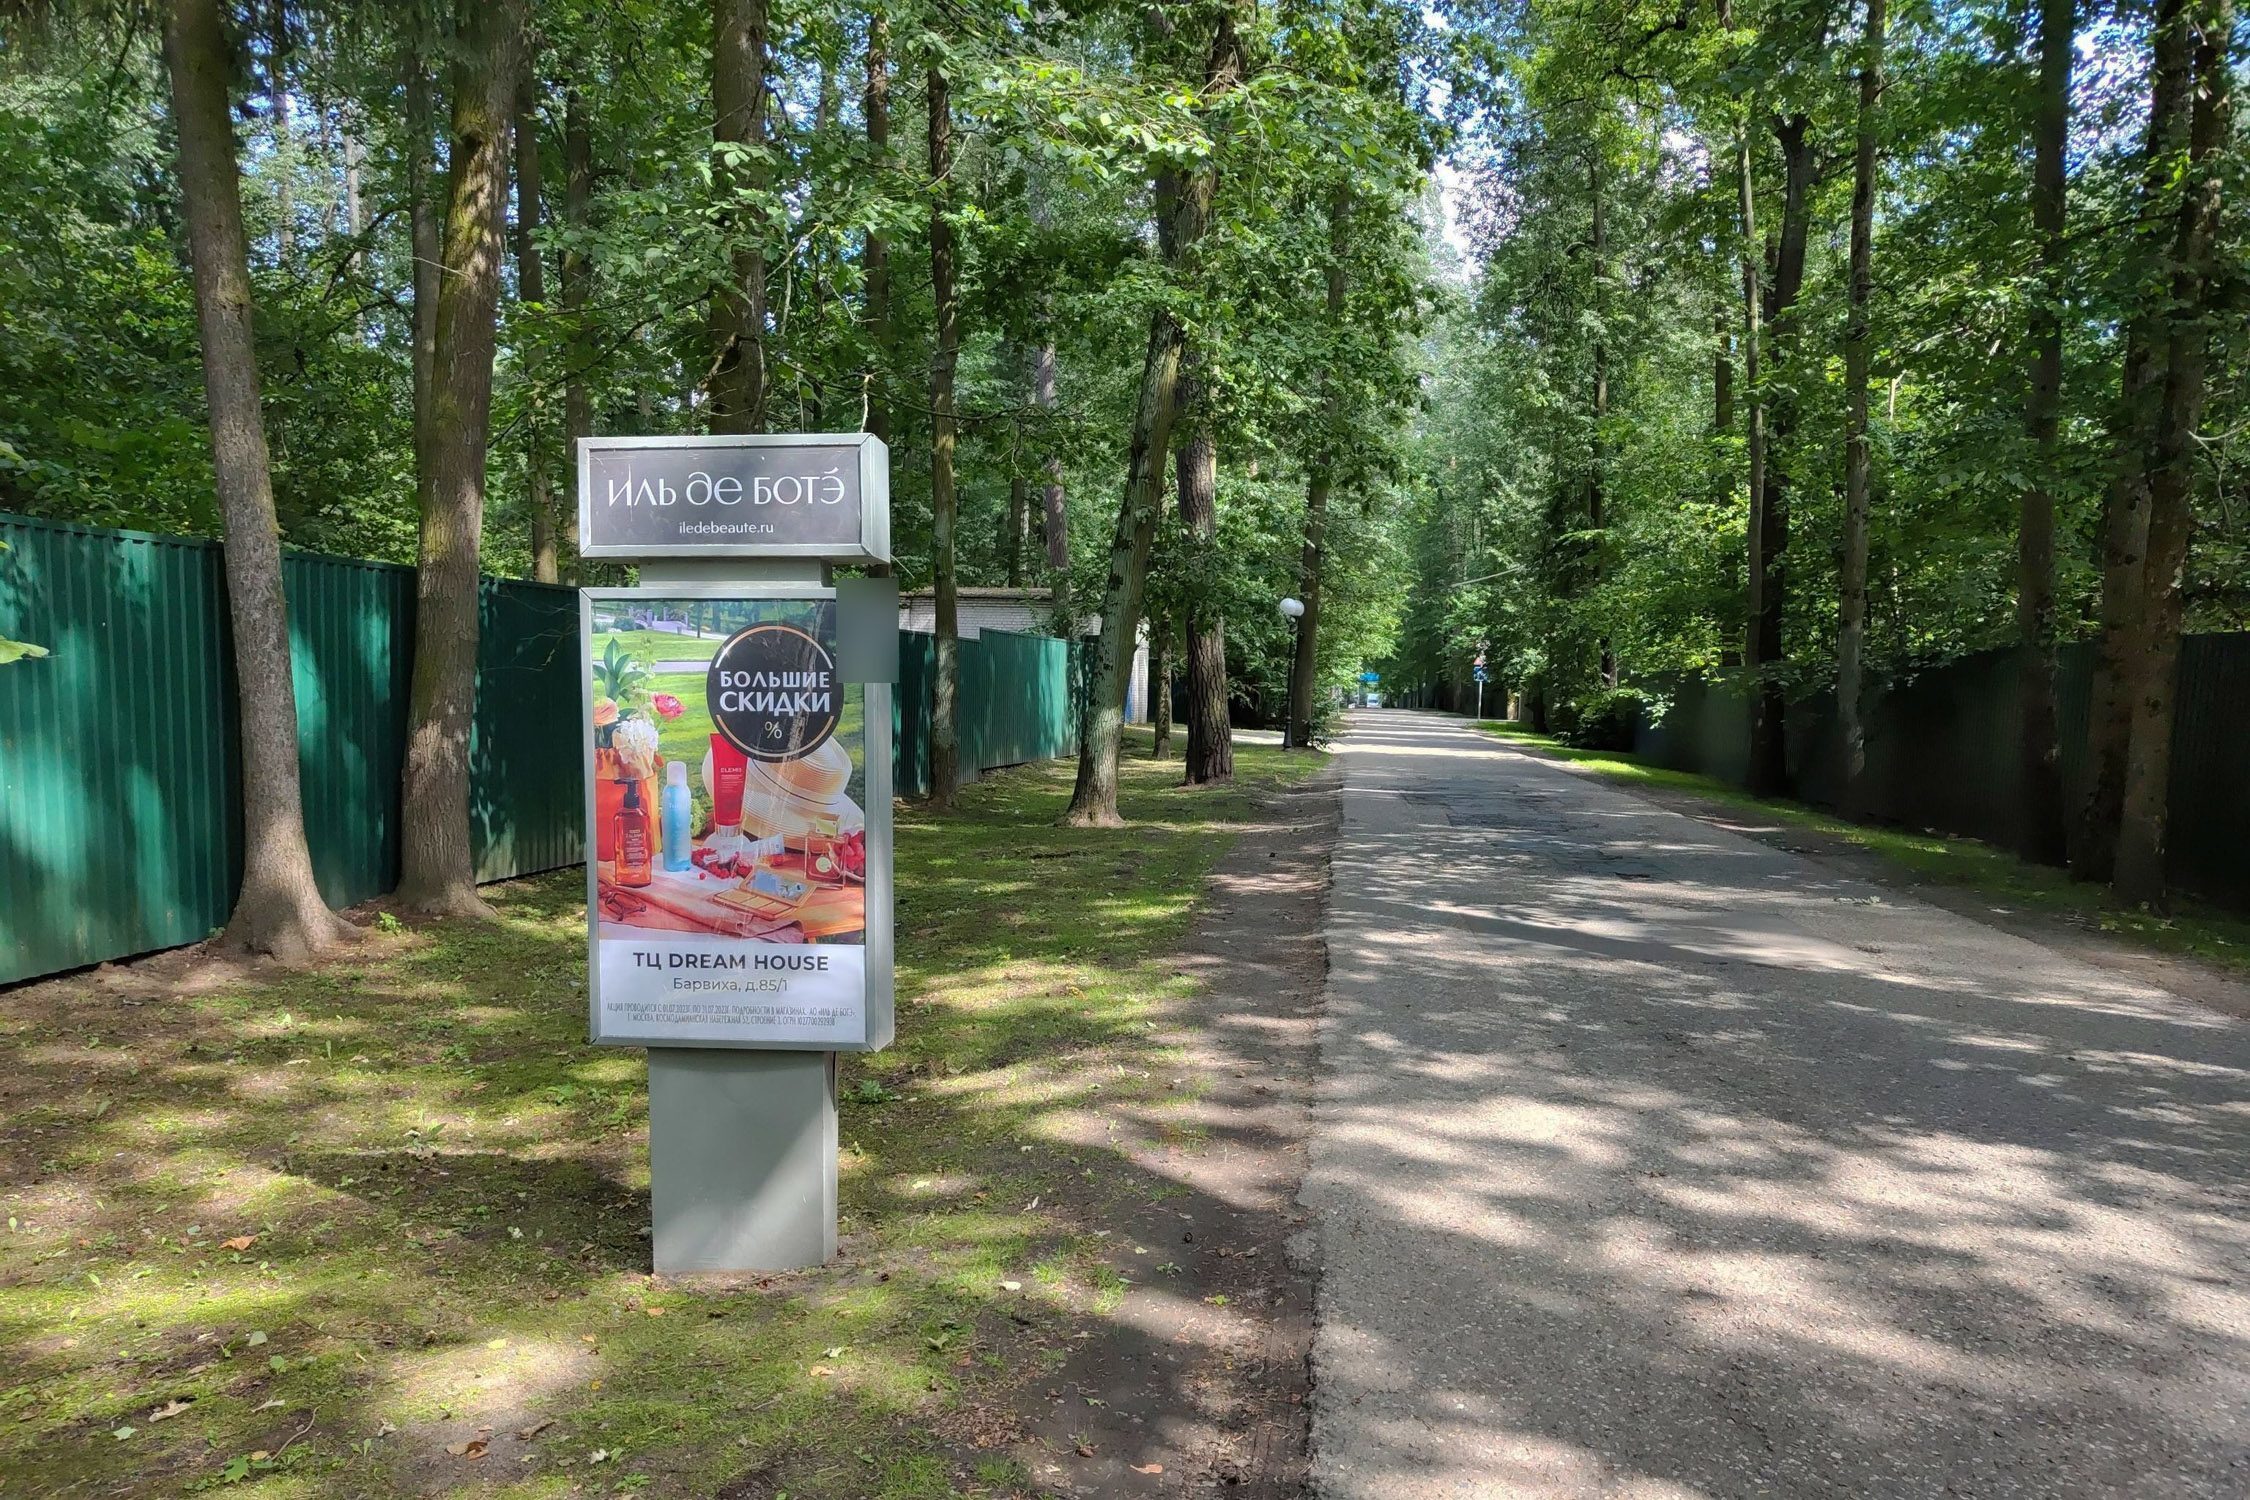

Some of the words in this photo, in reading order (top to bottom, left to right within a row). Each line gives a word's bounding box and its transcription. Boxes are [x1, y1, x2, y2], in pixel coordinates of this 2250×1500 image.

[679, 521, 774, 534] iledebeaute.ru
[720, 671, 830, 688] БОЛЬШИЕ
[719, 691, 830, 716] СКИДКИ
[764, 721, 783, 739] %
[633, 952, 662, 971] ТЦ
[669, 953, 746, 969] DREAM
[754, 954, 829, 971] HOUSE
[673, 977, 742, 992] Барвиха,
[745, 977, 788, 992] д.85/1
